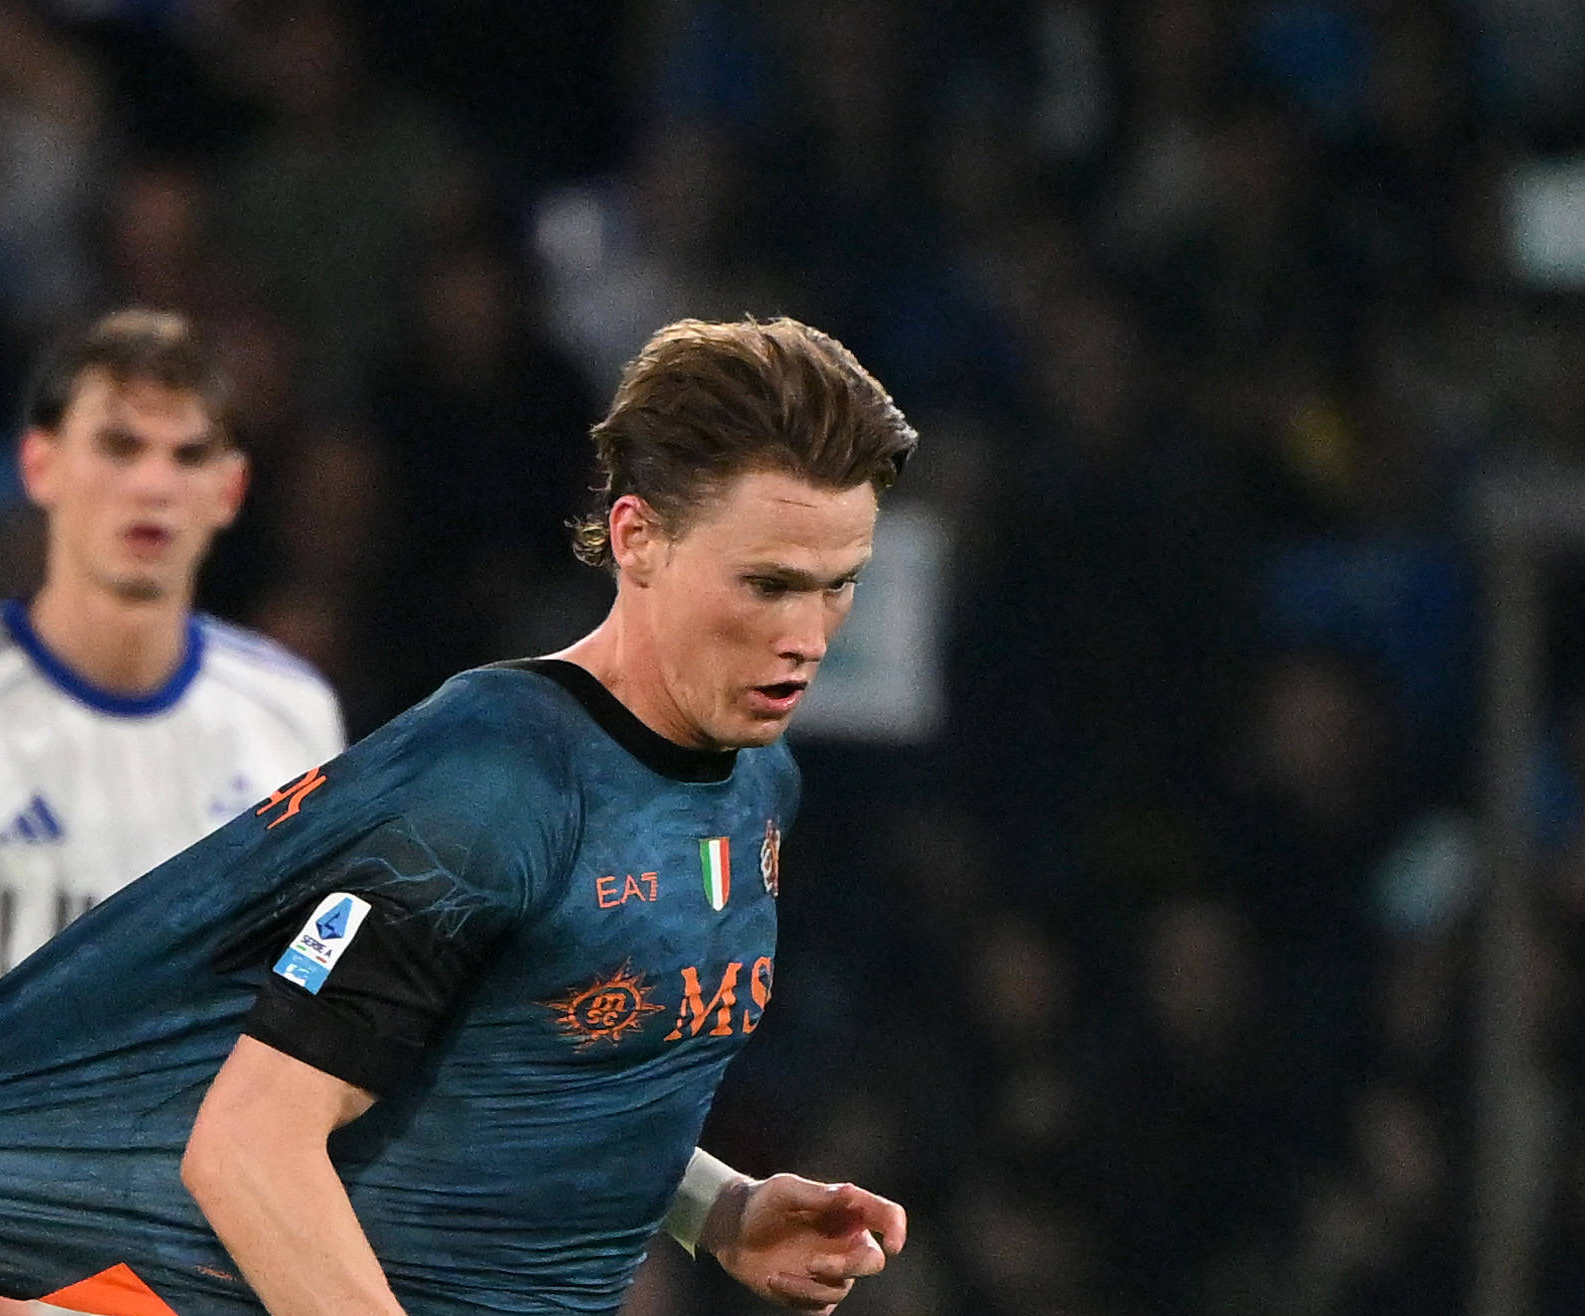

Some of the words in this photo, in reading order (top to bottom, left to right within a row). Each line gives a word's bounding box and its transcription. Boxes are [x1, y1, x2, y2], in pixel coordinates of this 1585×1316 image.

[596, 872, 658, 908] EA7
[300, 934, 327, 953] SERIE
[324, 949, 333, 958] A
